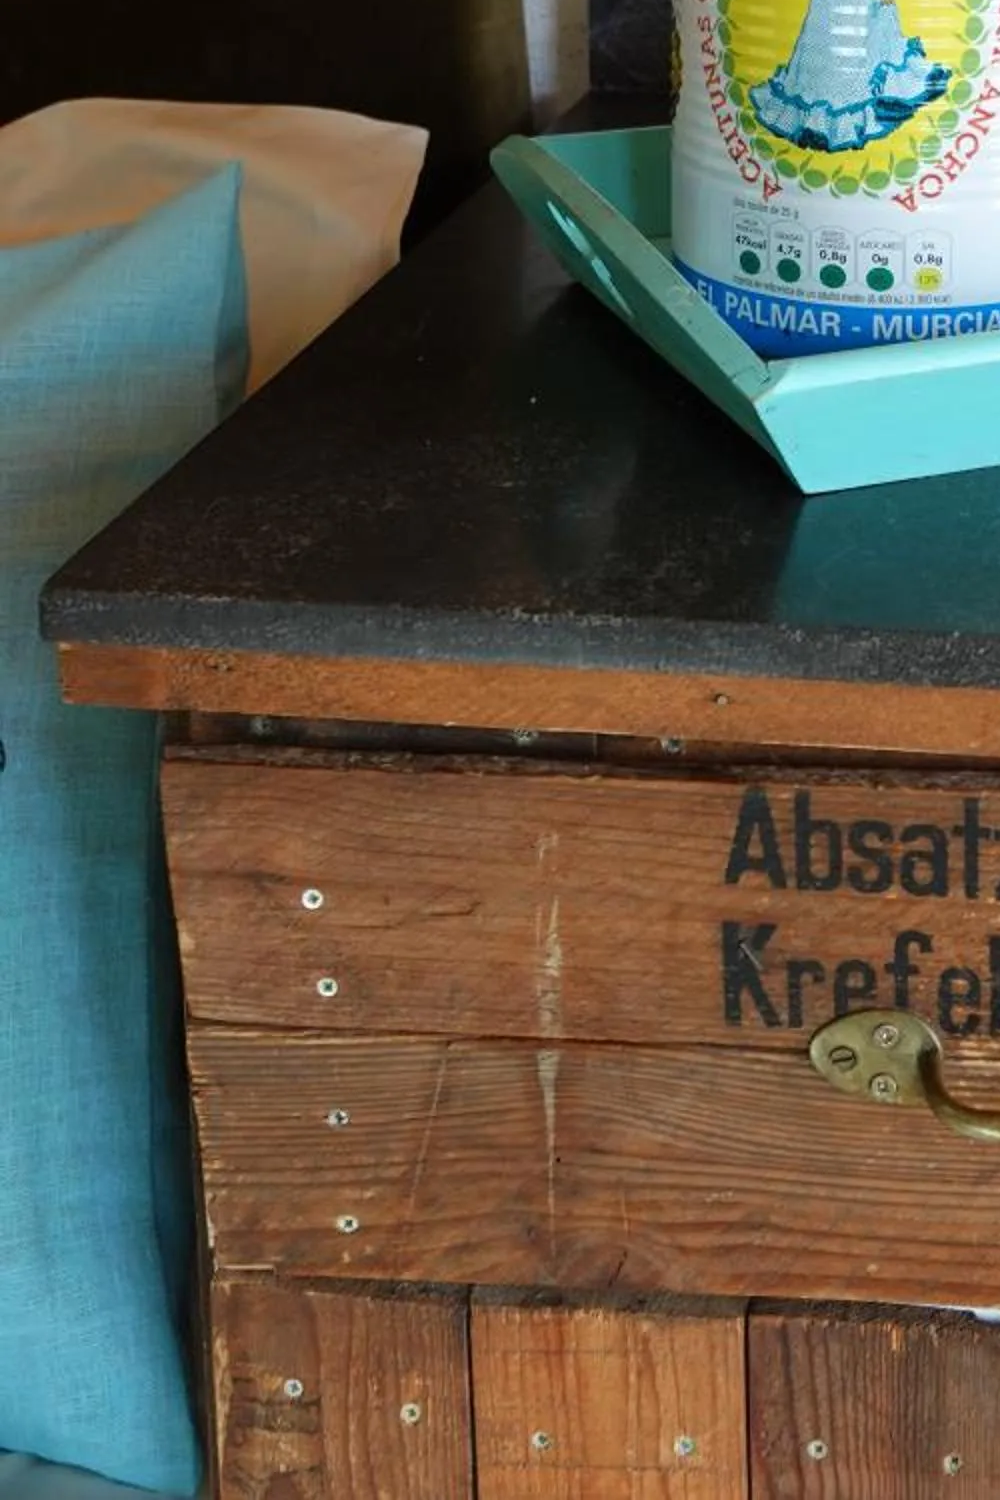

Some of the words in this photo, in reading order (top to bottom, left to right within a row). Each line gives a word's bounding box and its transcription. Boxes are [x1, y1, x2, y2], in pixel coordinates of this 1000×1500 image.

[697, 16, 783, 203] ACEITUNAS
[872, 254, 889, 266] 0g
[724, 292, 841, 337] PALMAR
